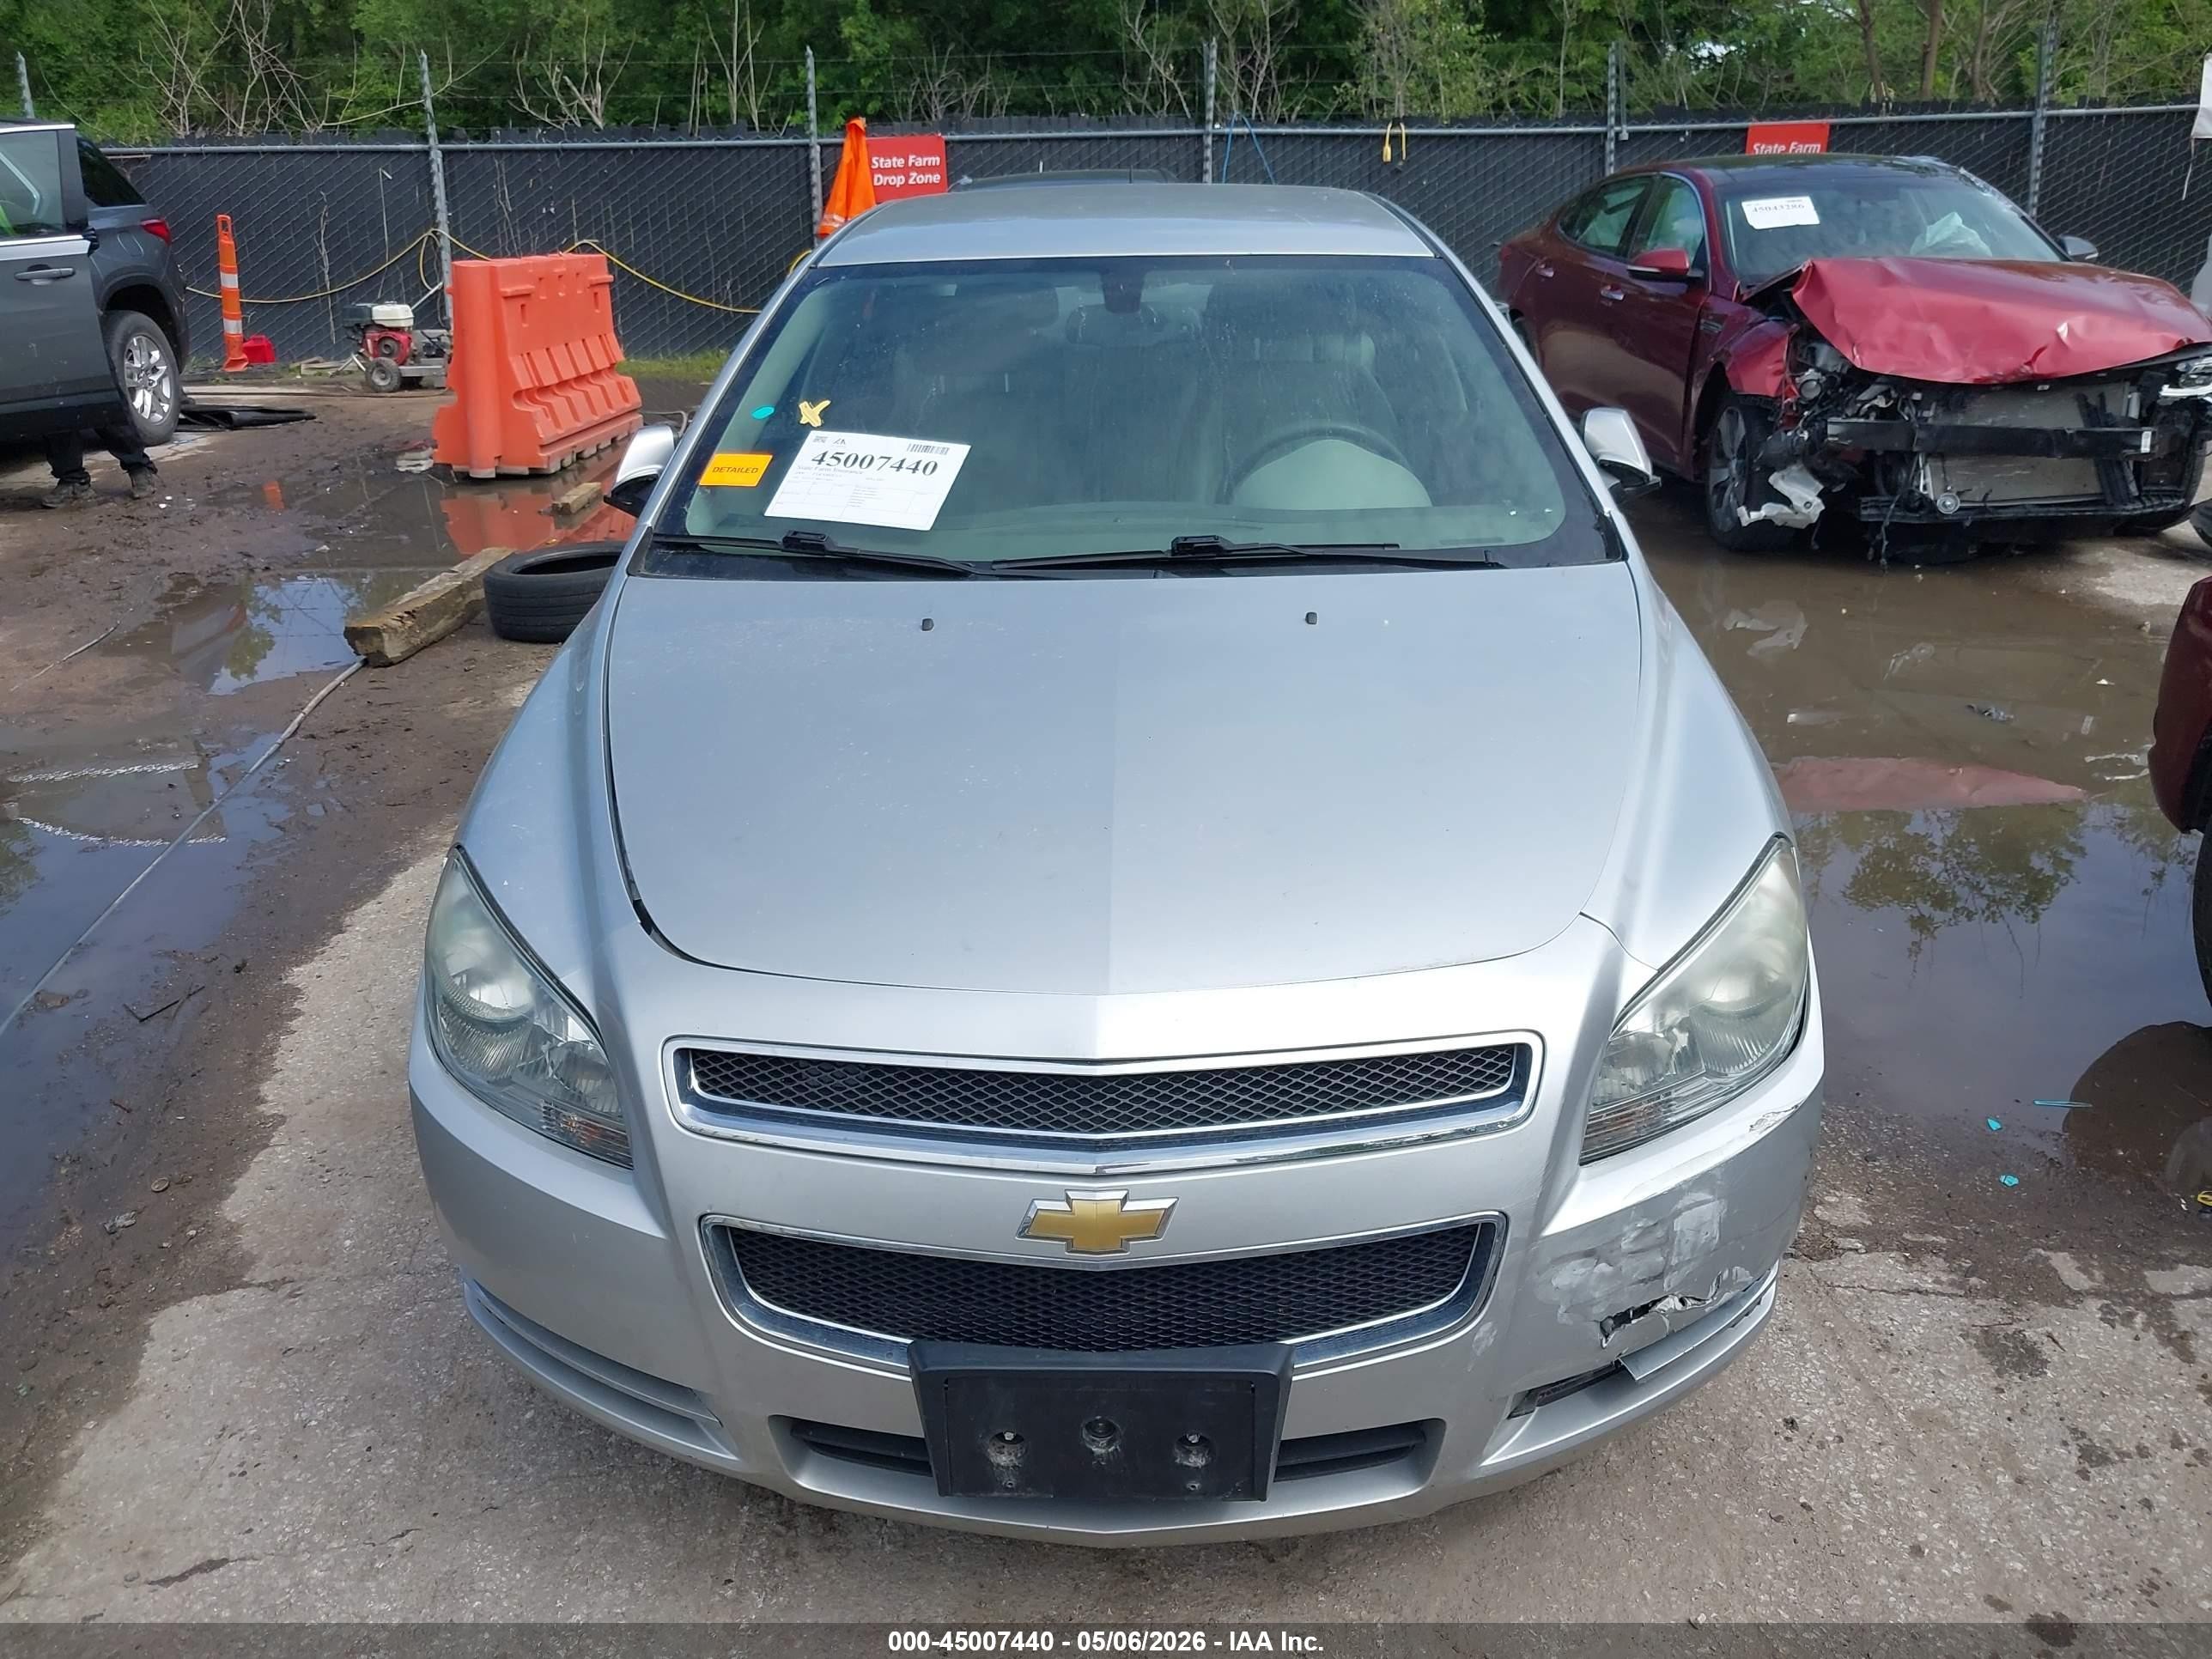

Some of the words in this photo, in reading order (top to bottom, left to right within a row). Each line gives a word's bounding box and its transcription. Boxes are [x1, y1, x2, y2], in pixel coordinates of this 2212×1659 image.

[1753, 143, 1786, 155] State
[1789, 141, 1821, 154] Farm
[871, 156, 905, 169] State
[908, 155, 940, 167] Farm
[873, 173, 906, 188] Drop
[908, 172, 941, 185] Zone
[811, 450, 939, 477] 45007440
